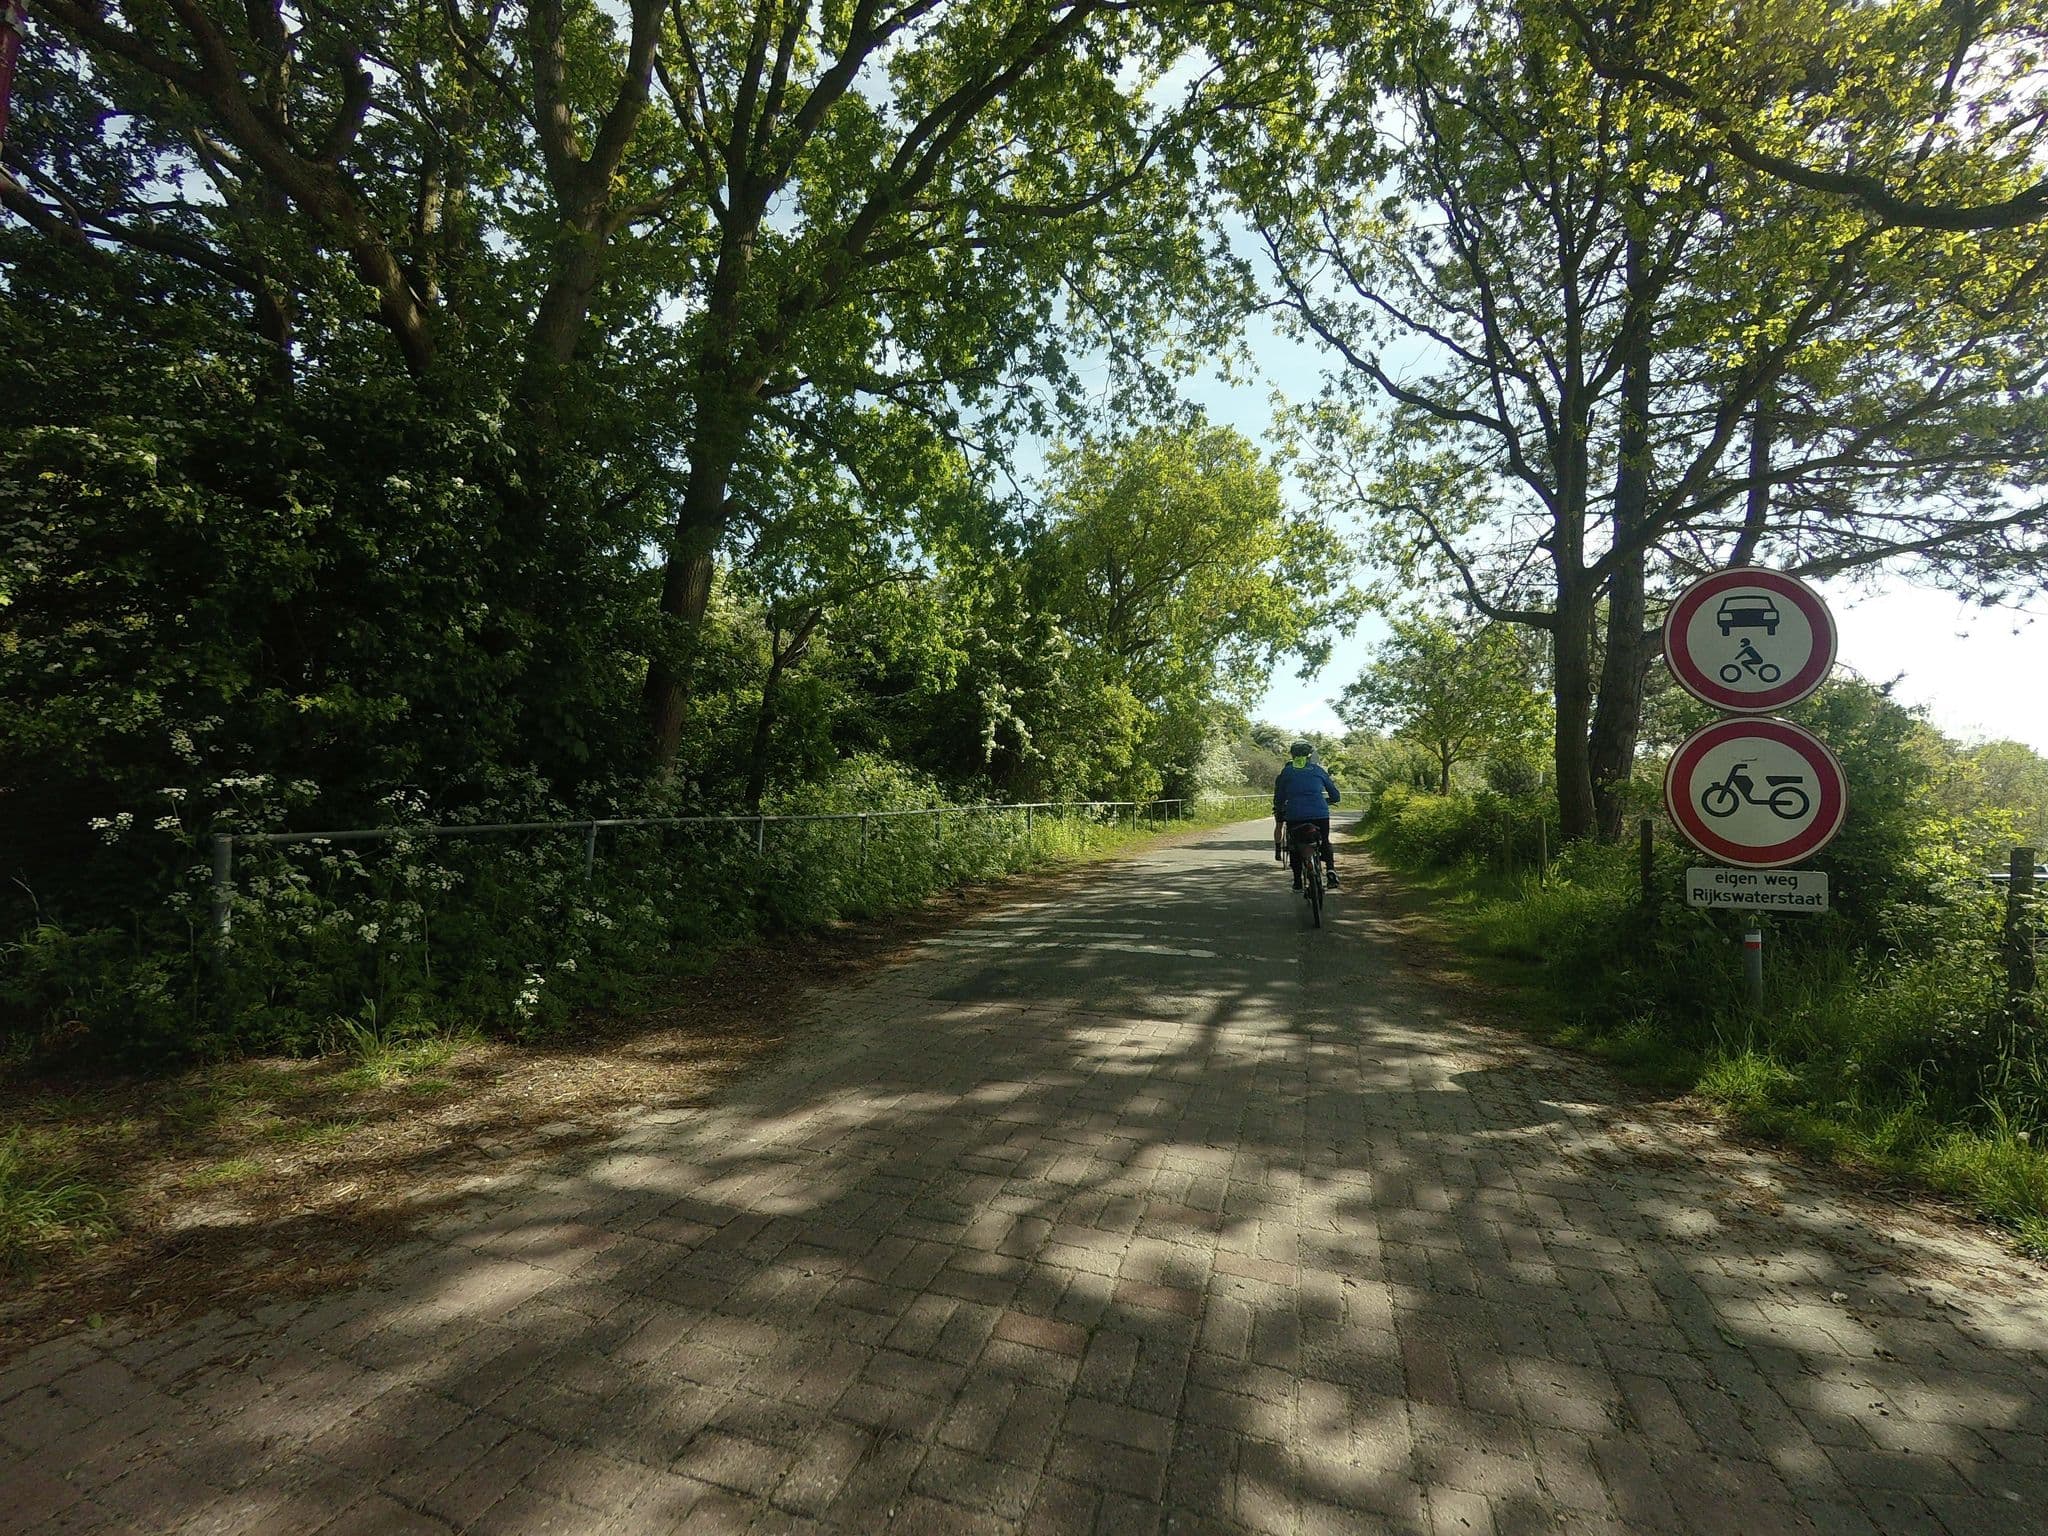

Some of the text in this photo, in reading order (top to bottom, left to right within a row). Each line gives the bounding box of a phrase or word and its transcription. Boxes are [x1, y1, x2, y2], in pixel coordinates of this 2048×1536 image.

[1715, 871, 1798, 890] eigen weg
[1693, 888, 1823, 906] Rijkswaterstaat
